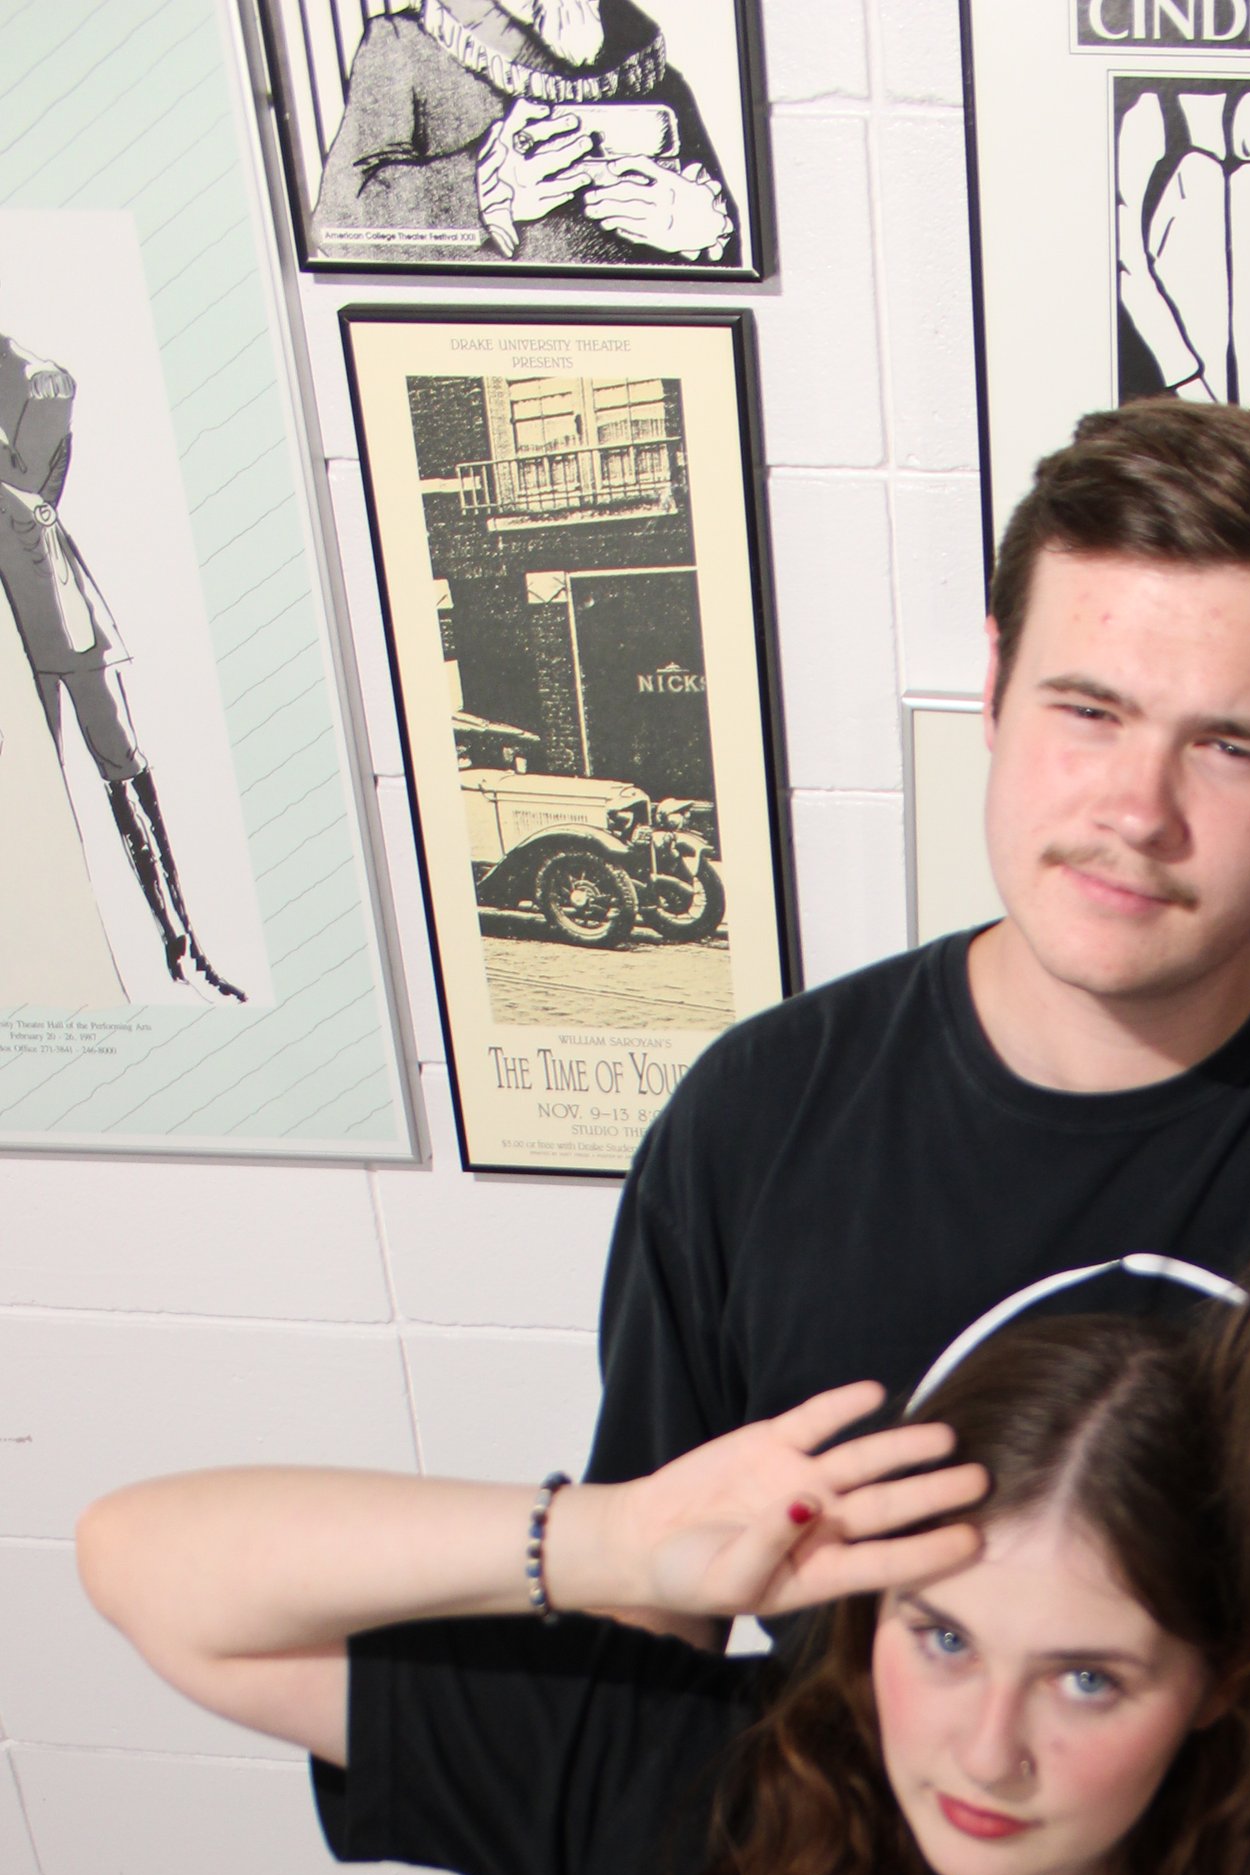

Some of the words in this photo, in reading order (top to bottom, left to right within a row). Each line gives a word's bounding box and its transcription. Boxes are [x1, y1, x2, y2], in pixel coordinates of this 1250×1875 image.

[325, 232, 363, 240] American
[366, 232, 396, 242] College
[430, 233, 458, 241] Festival
[450, 339, 493, 350] DRAKE
[499, 339, 571, 351] UNIVERSITY
[576, 339, 631, 352] THEATRE
[512, 356, 573, 368] PRESENTS
[47, 1020, 63, 1029] Hall
[66, 1021, 74, 1029] of
[91, 1022, 132, 1032] Performing
[136, 1023, 152, 1031] Arts
[10, 1032, 43, 1041] February
[558, 1035, 606, 1046] WILLIAM
[609, 1037, 672, 1048] SAROYAN'S
[14, 1044, 38, 1053] Office
[488, 1046, 533, 1090] THE
[537, 1048, 590, 1092] TIME
[595, 1060, 624, 1094] OF
[537, 1103, 583, 1120] NOV.
[571, 1124, 619, 1137] STUDIO
[556, 1140, 576, 1150] with
[578, 1141, 604, 1151] Drake
